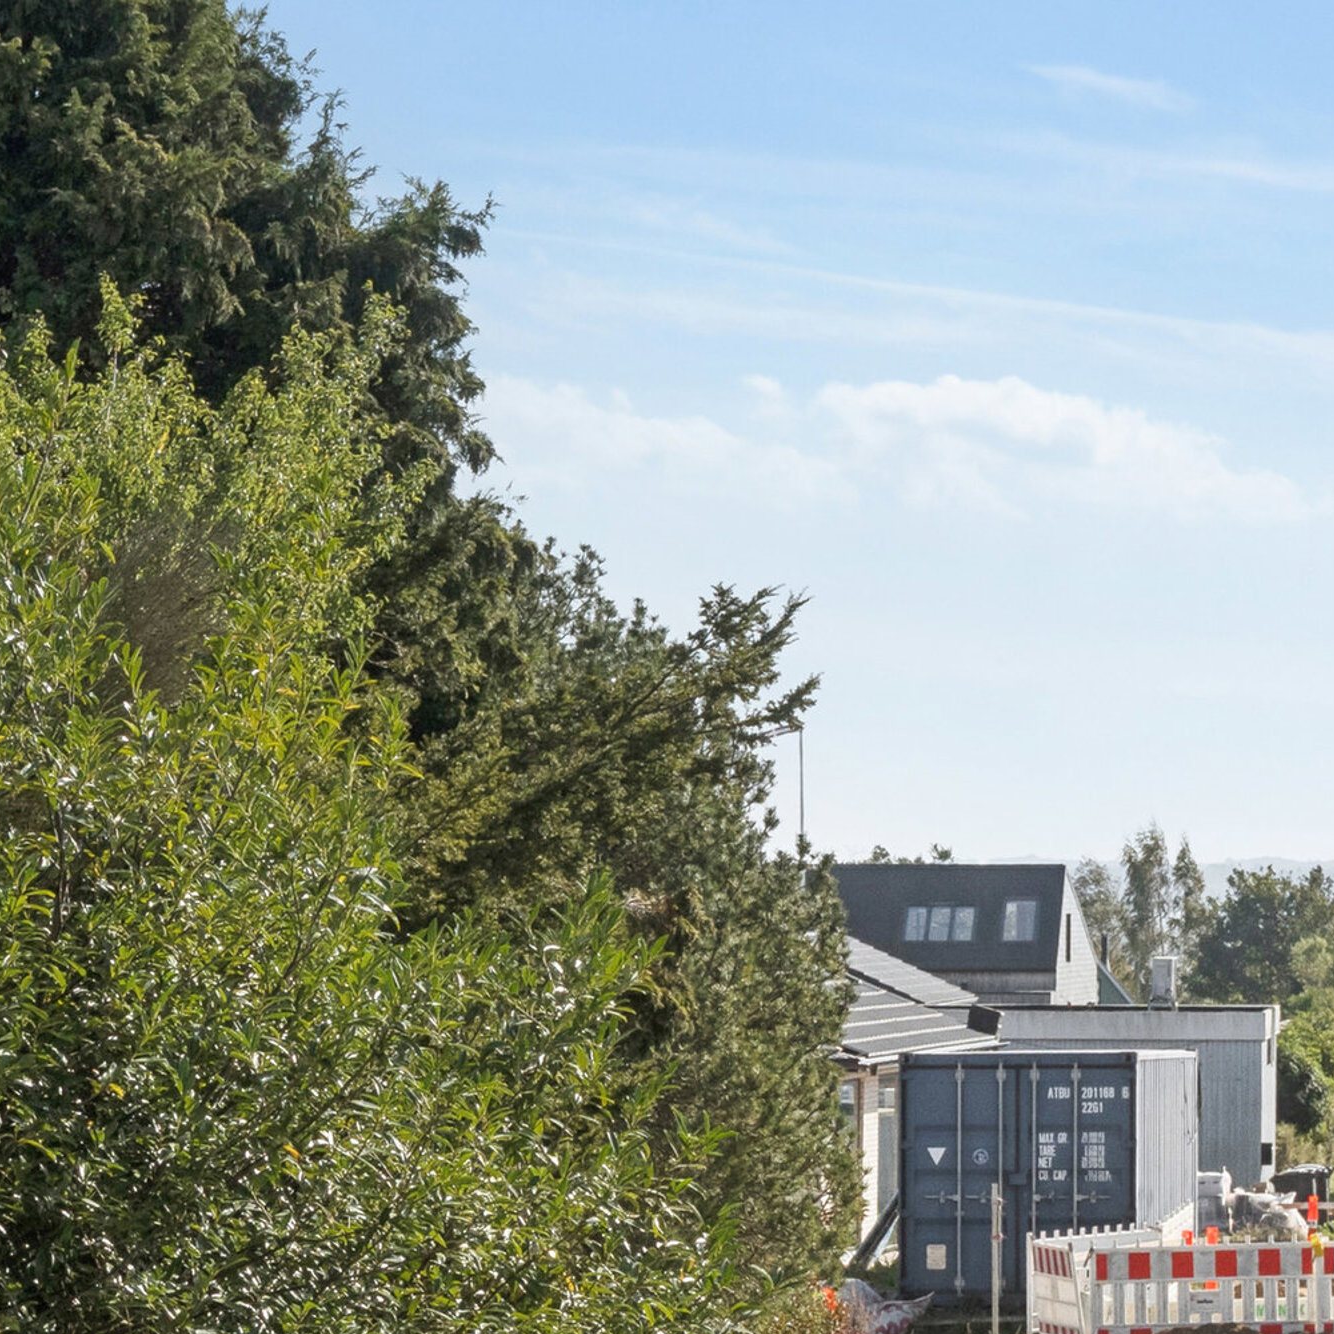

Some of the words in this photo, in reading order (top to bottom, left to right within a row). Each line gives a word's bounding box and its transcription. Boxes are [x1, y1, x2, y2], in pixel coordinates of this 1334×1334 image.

[1047, 1086, 1071, 1099] ATBU
[1081, 1086, 1115, 1099] 201168
[1121, 1086, 1130, 1099] 6
[1081, 1101, 1104, 1114] 22G1
